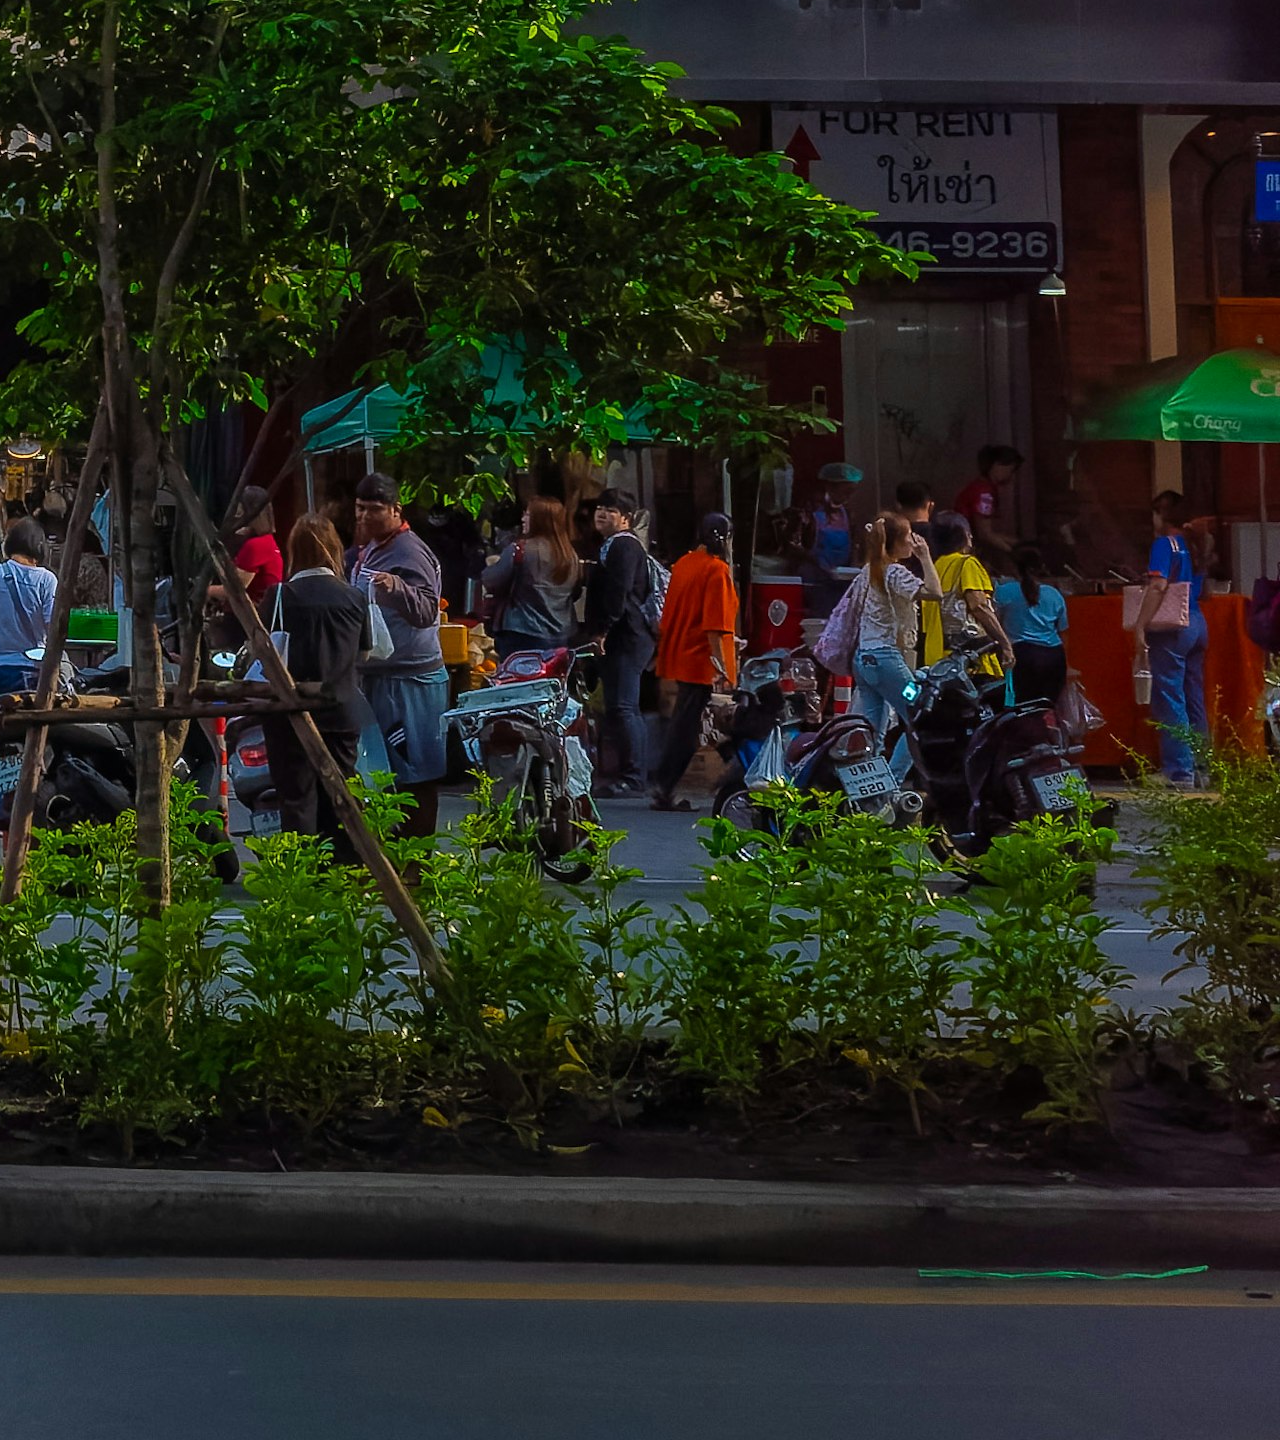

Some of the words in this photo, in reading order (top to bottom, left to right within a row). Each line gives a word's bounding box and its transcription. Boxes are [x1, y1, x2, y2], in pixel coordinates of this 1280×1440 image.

[818, 111, 898, 136] FOR
[915, 111, 1012, 138] RENT
[876, 154, 997, 205] ให้เช่า
[859, 781, 886, 796] 620
